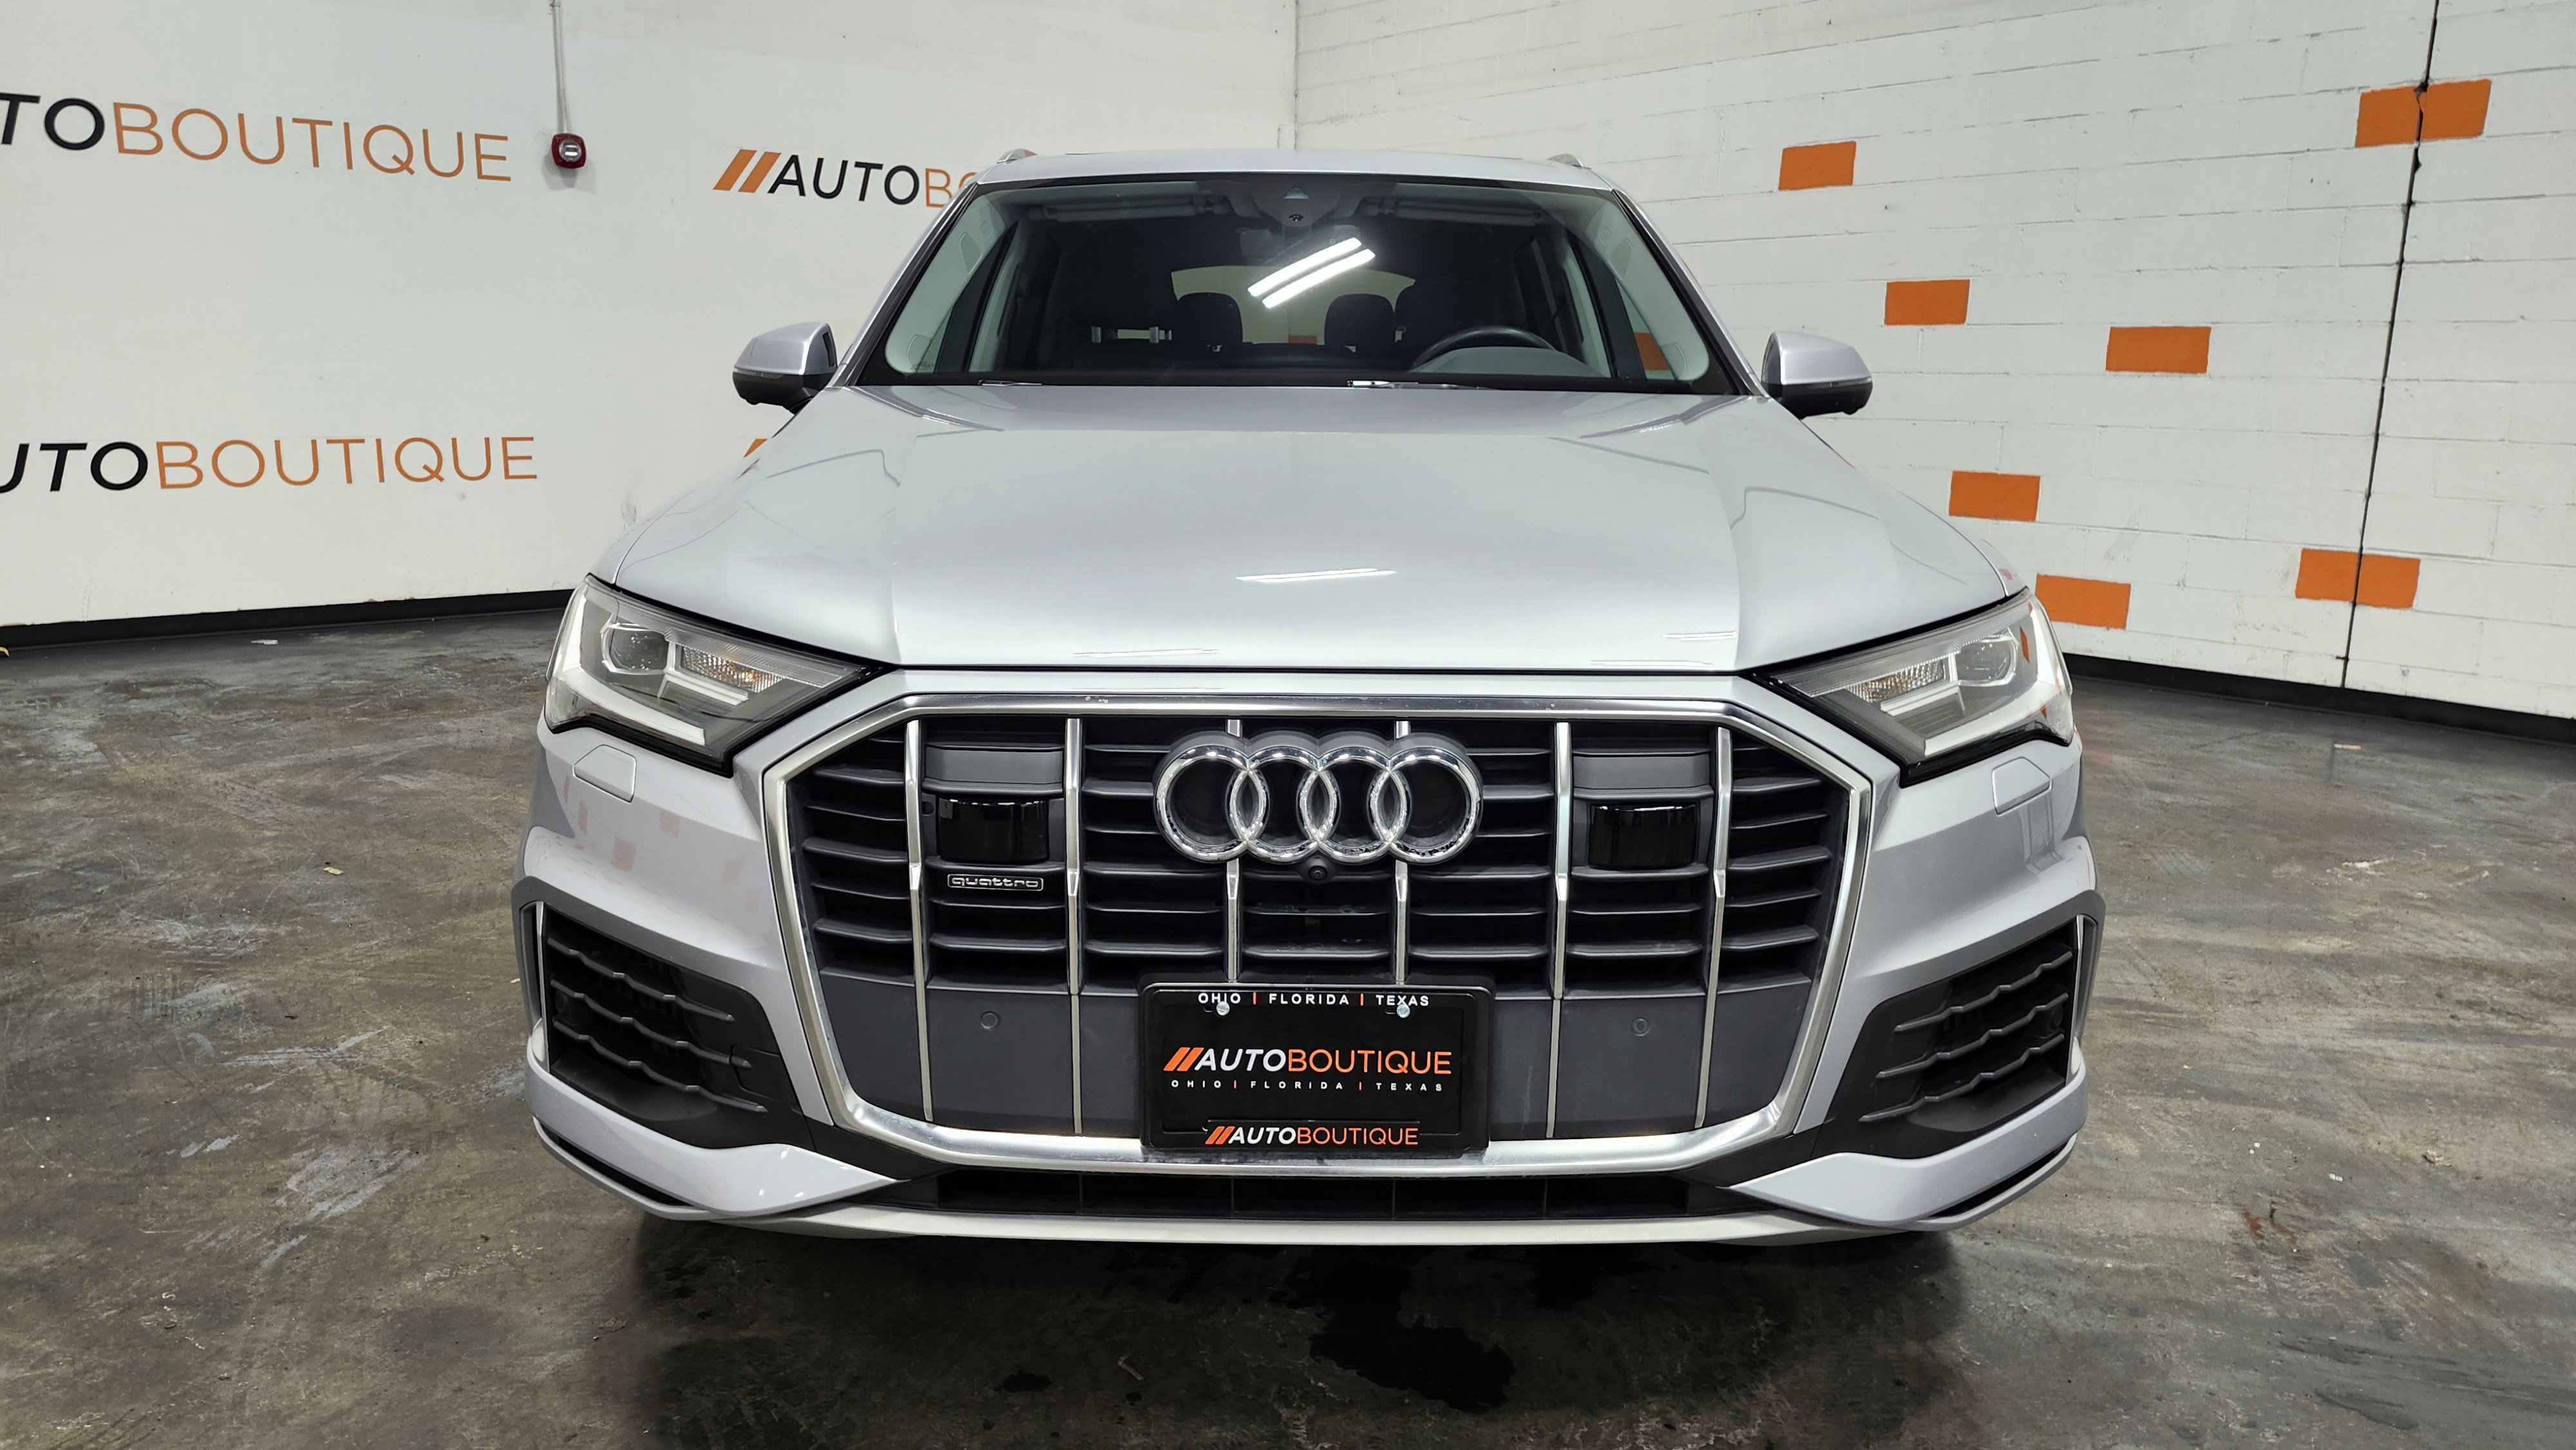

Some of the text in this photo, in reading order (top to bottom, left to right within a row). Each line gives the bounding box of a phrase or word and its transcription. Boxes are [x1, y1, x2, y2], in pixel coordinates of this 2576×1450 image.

[767, 155, 978, 208] AUTOB
[951, 876, 1039, 888] quattro
[1198, 992, 1429, 1006] OHIO FLORIDA TEXAS
[1194, 1048, 1452, 1075] AUTOBOUTIQUE
[1171, 1080, 1442, 1091] OHIO FLORIDA TEXAS
[1228, 1126, 1418, 1145] AUTOBOUTIQUE
